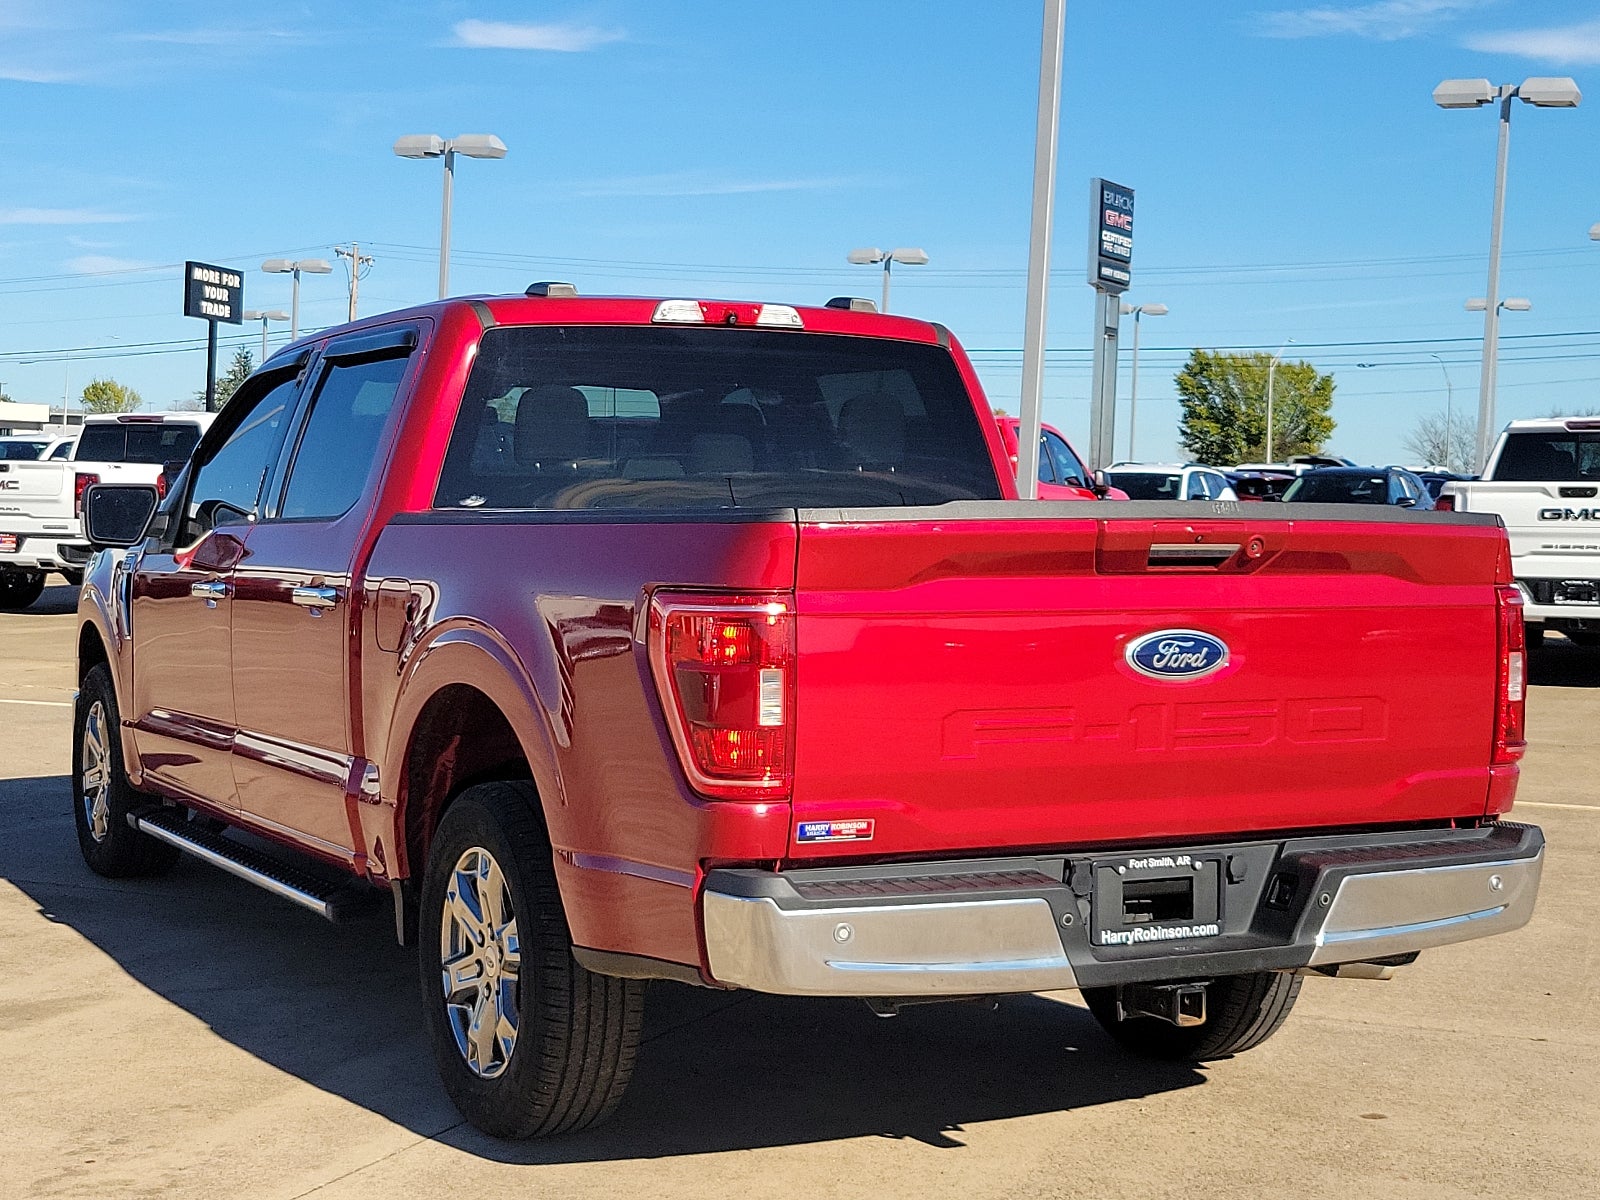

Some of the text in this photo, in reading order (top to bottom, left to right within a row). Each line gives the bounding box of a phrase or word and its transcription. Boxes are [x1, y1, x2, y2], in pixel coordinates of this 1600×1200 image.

[1103, 191, 1133, 212] BUICK
[1105, 209, 1132, 231] GMC
[194, 267, 240, 288] MORE FOR
[204, 285, 229, 302] YOUR
[201, 301, 231, 318] TRADE
[1152, 640, 1209, 668] Ford
[941, 695, 1389, 761] F-150
[805, 821, 868, 831] HARRY ROBINSON
[1129, 855, 1192, 869] Fort Smith, AR
[1101, 924, 1219, 945] HarryRobinson.com
